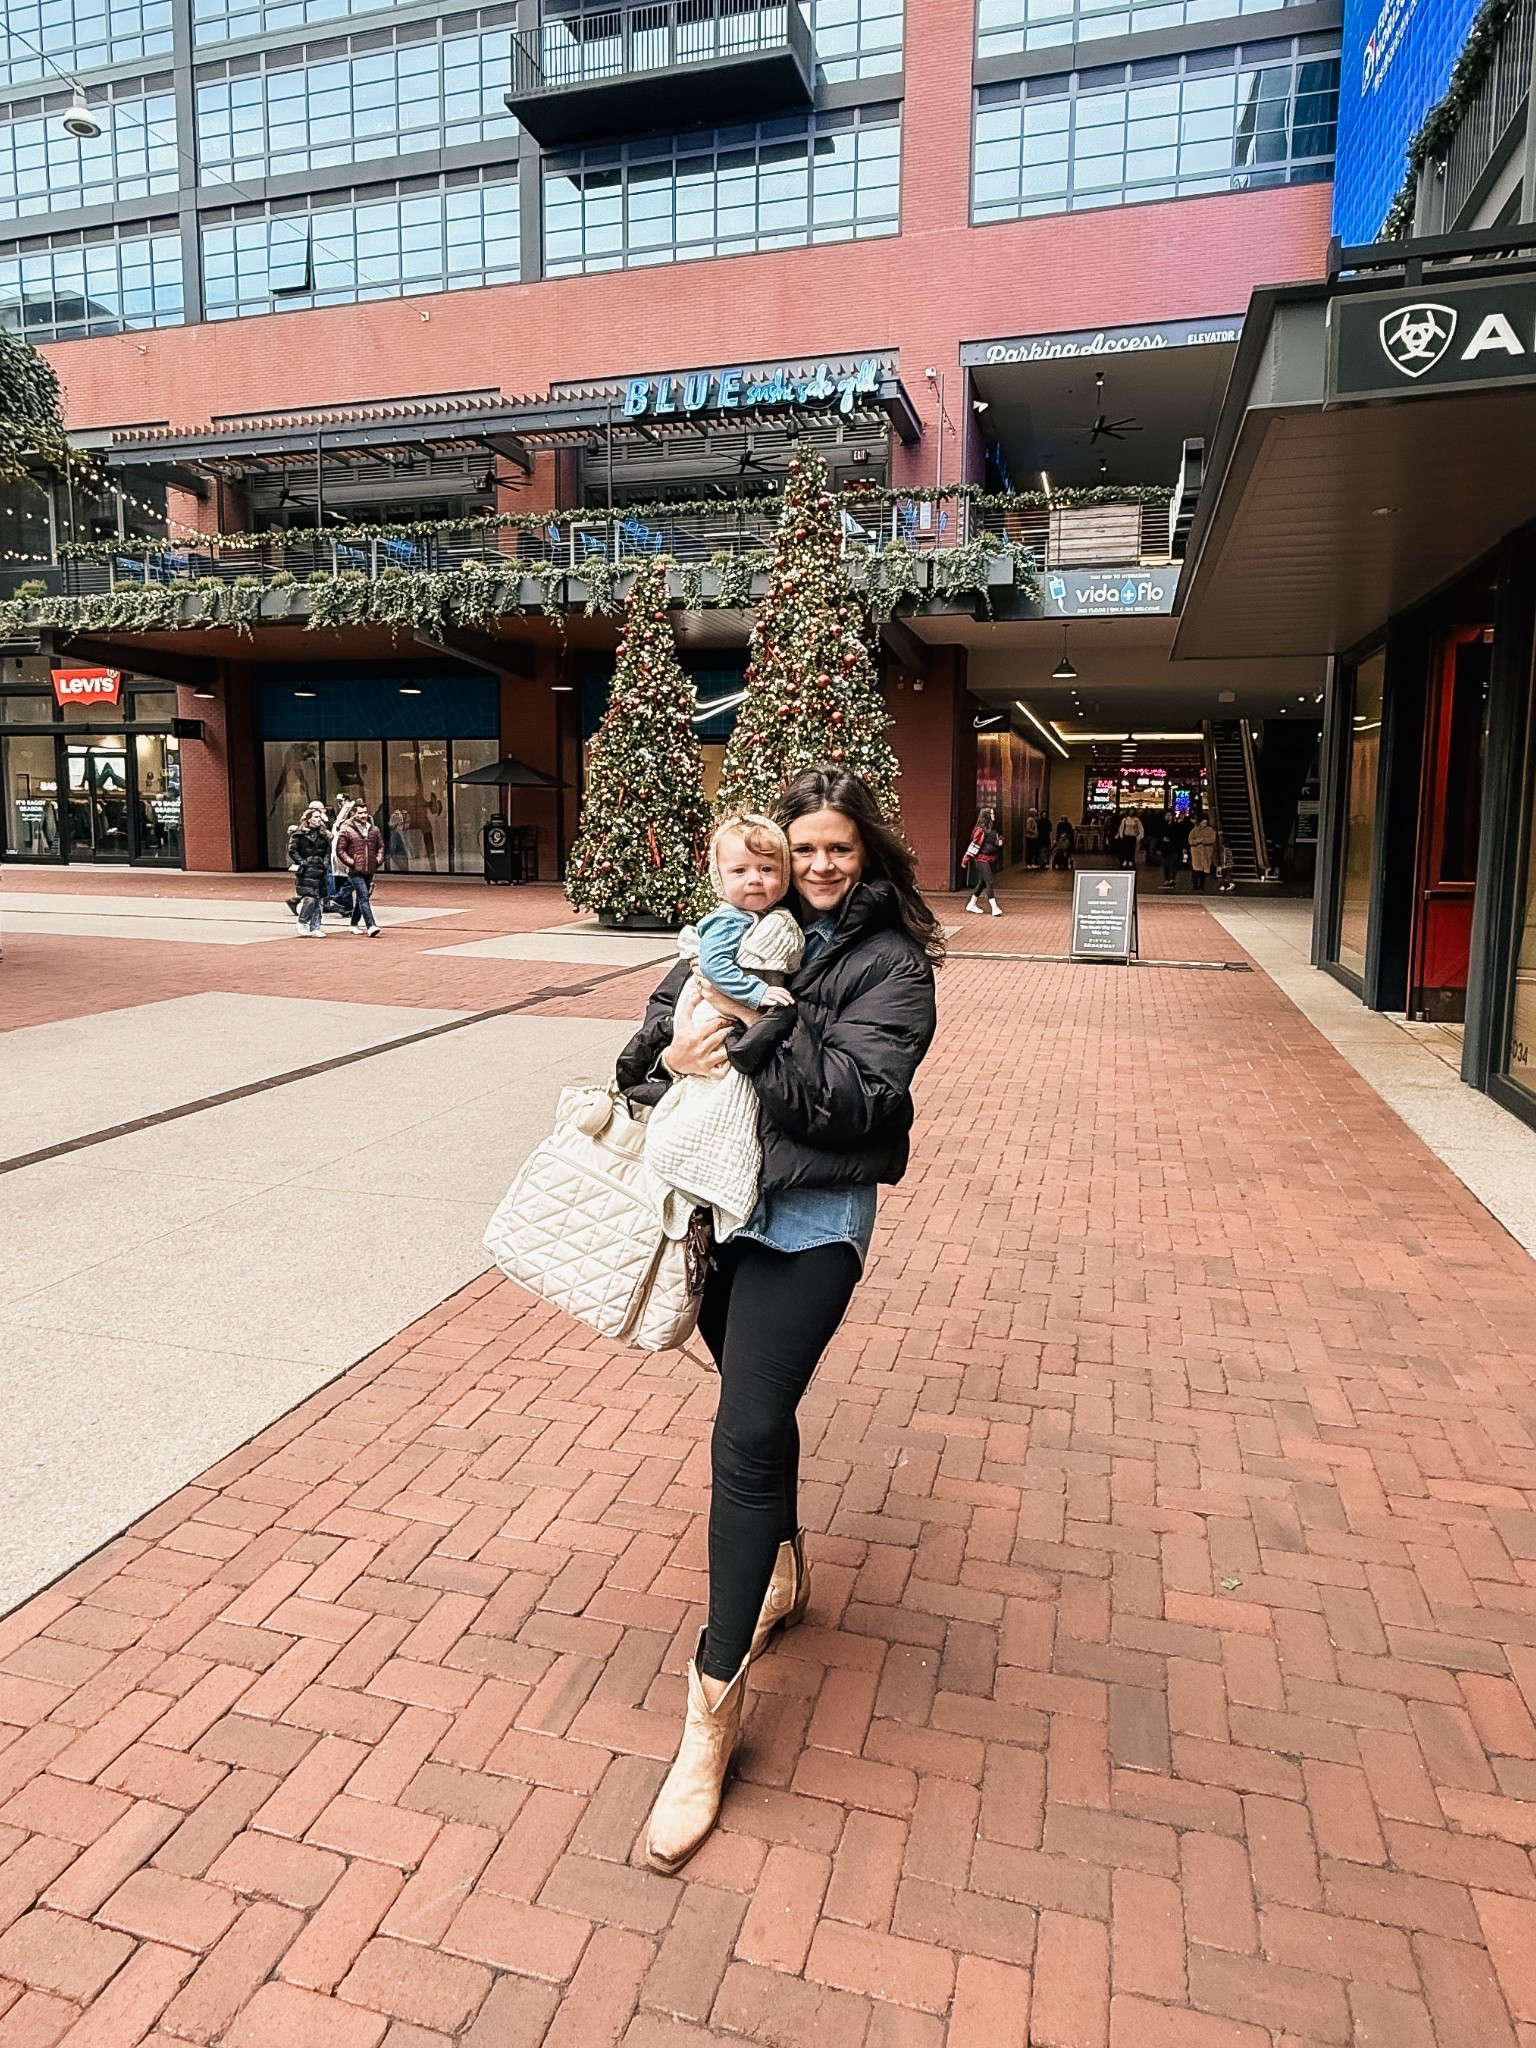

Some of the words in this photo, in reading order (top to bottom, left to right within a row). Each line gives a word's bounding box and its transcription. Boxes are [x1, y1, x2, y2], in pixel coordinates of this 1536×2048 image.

[986, 341, 1080, 364] Parking
[1081, 333, 1167, 356] Access
[1187, 331, 1236, 344] ELEVATOR
[1461, 313, 1536, 361] A
[624, 368, 744, 417] BLUE
[837, 358, 879, 413] grill
[1075, 583, 1119, 603] vida
[1137, 582, 1164, 601] flo
